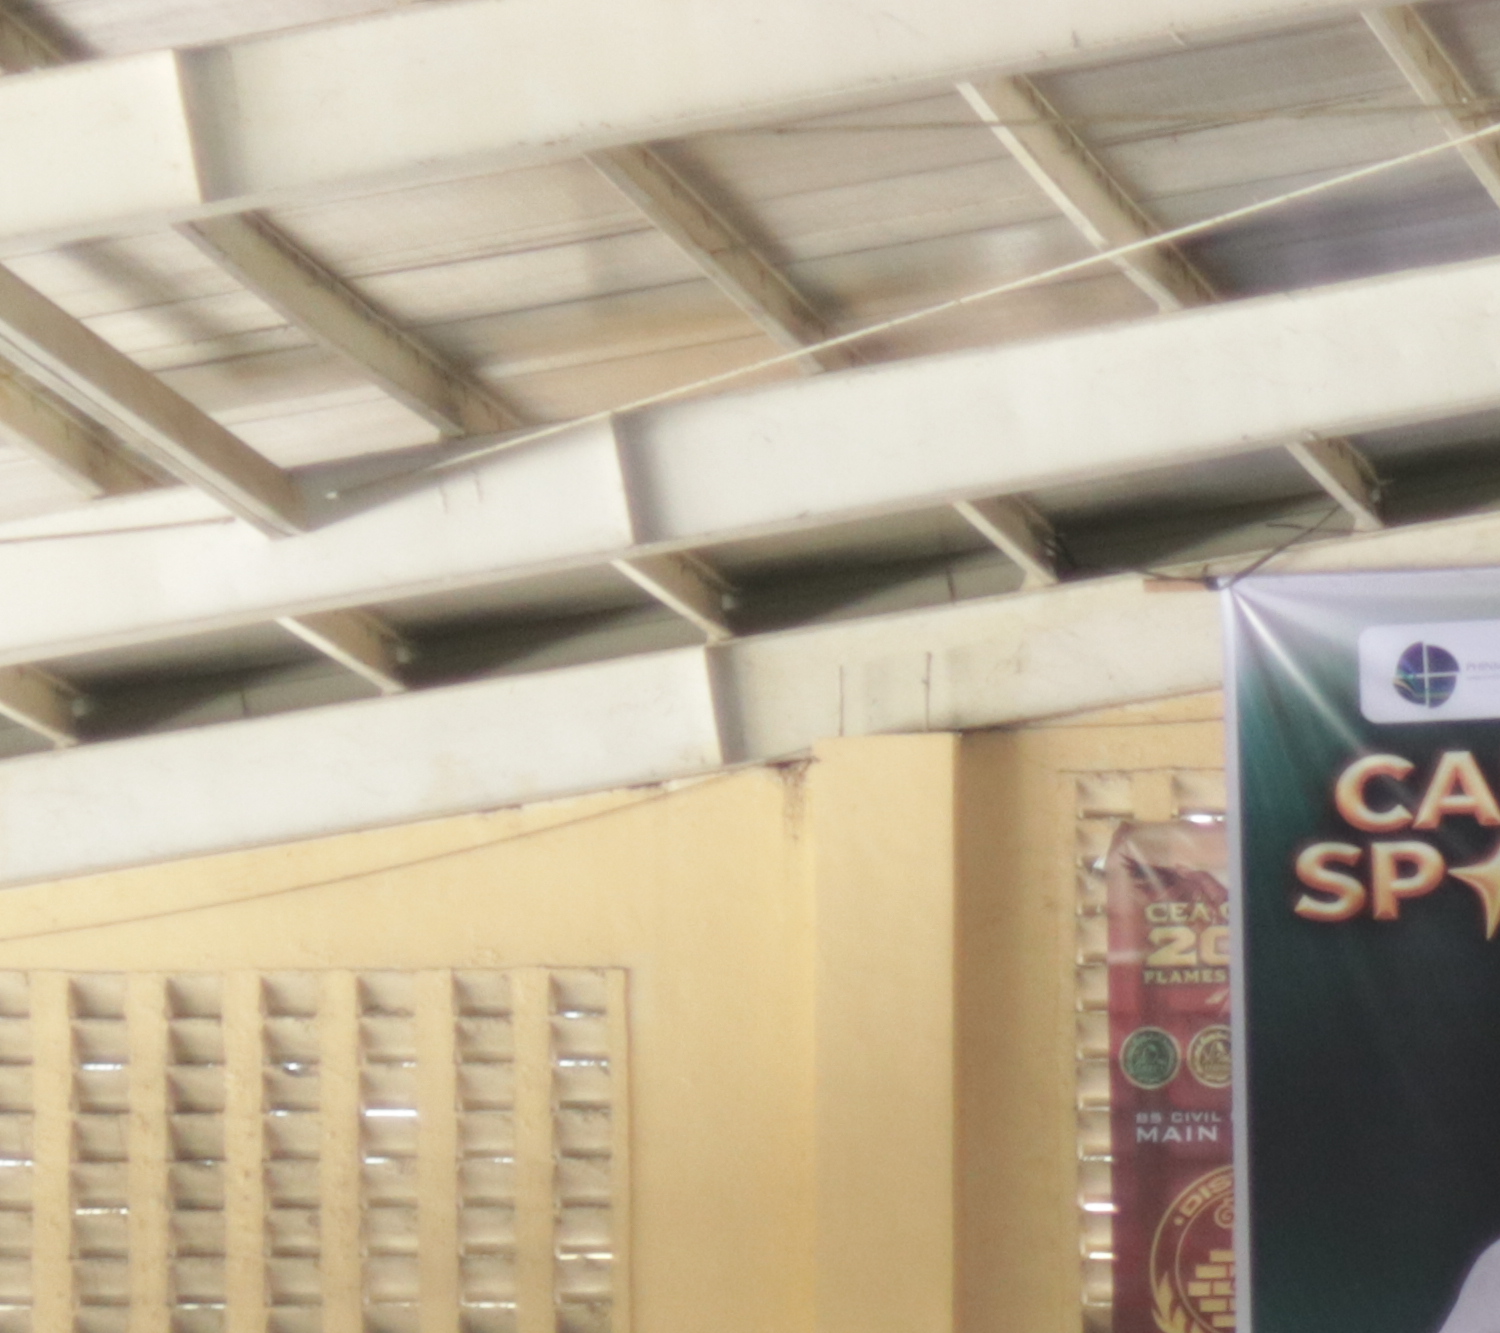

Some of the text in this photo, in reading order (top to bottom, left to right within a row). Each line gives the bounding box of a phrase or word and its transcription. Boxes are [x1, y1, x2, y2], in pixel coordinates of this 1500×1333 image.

[1143, 969, 1226, 985] FLAMES
[1171, 1112, 1221, 1124] CIVIL
[1136, 1126, 1218, 1144] MAIN
